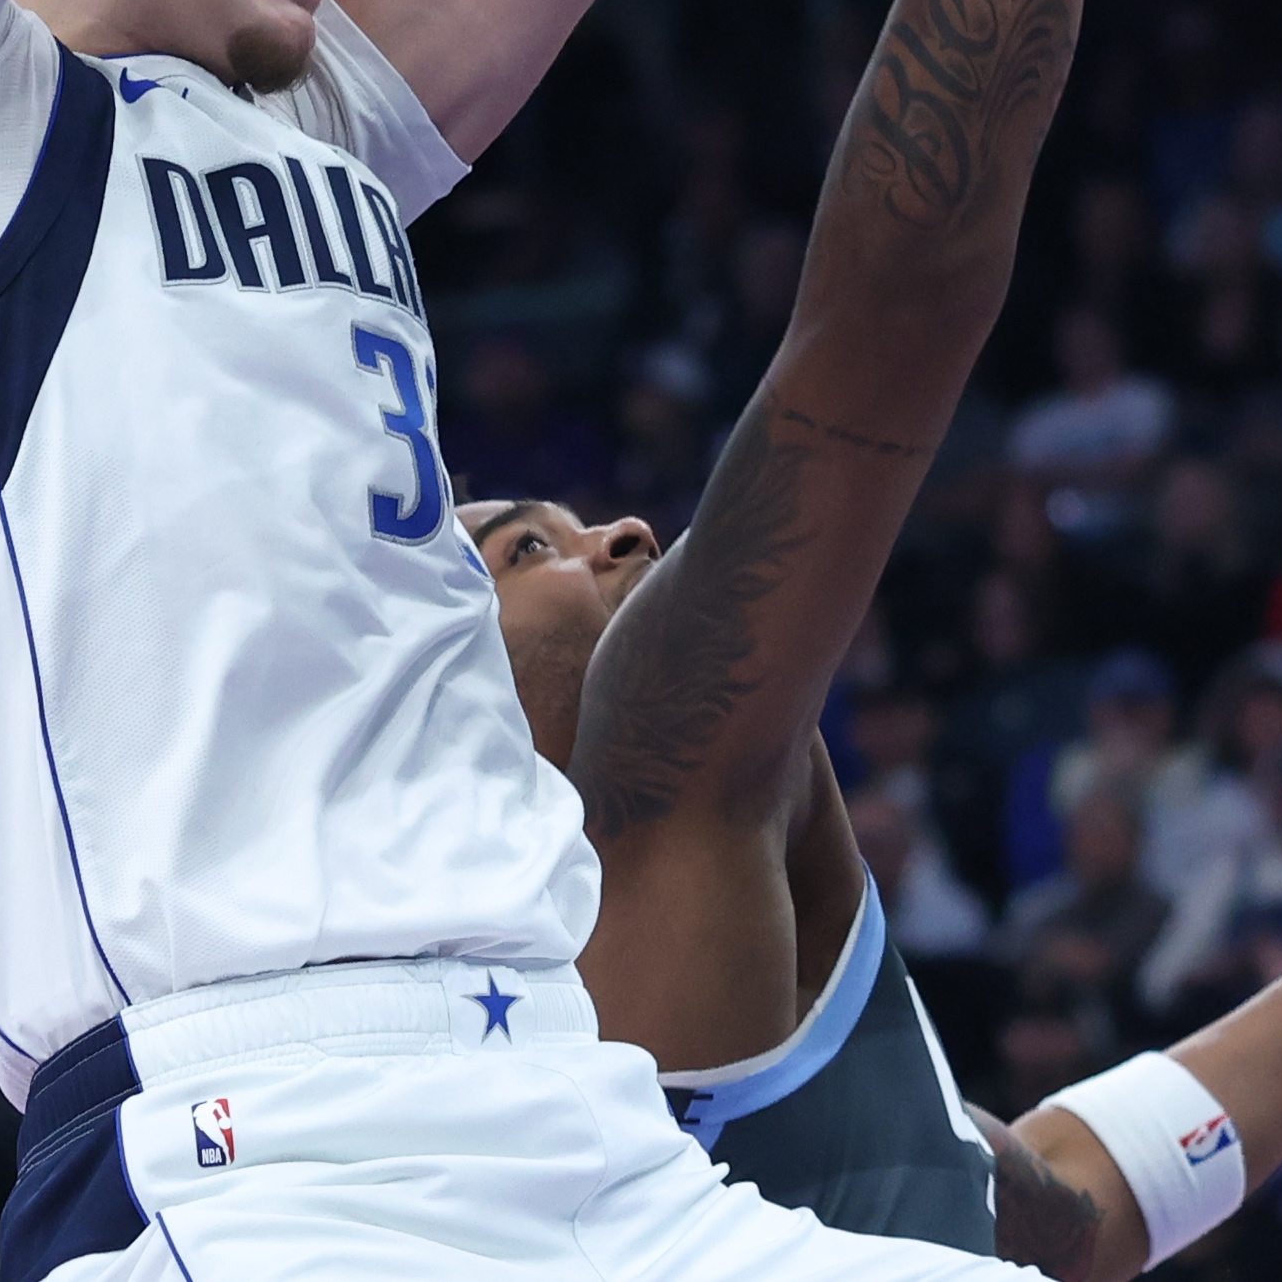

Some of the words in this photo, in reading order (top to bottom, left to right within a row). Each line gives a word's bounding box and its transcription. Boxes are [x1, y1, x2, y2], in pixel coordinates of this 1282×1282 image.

[135, 152, 424, 320] DALLA
[350, 319, 446, 546] 3
[201, 1147, 223, 1165] NBA
